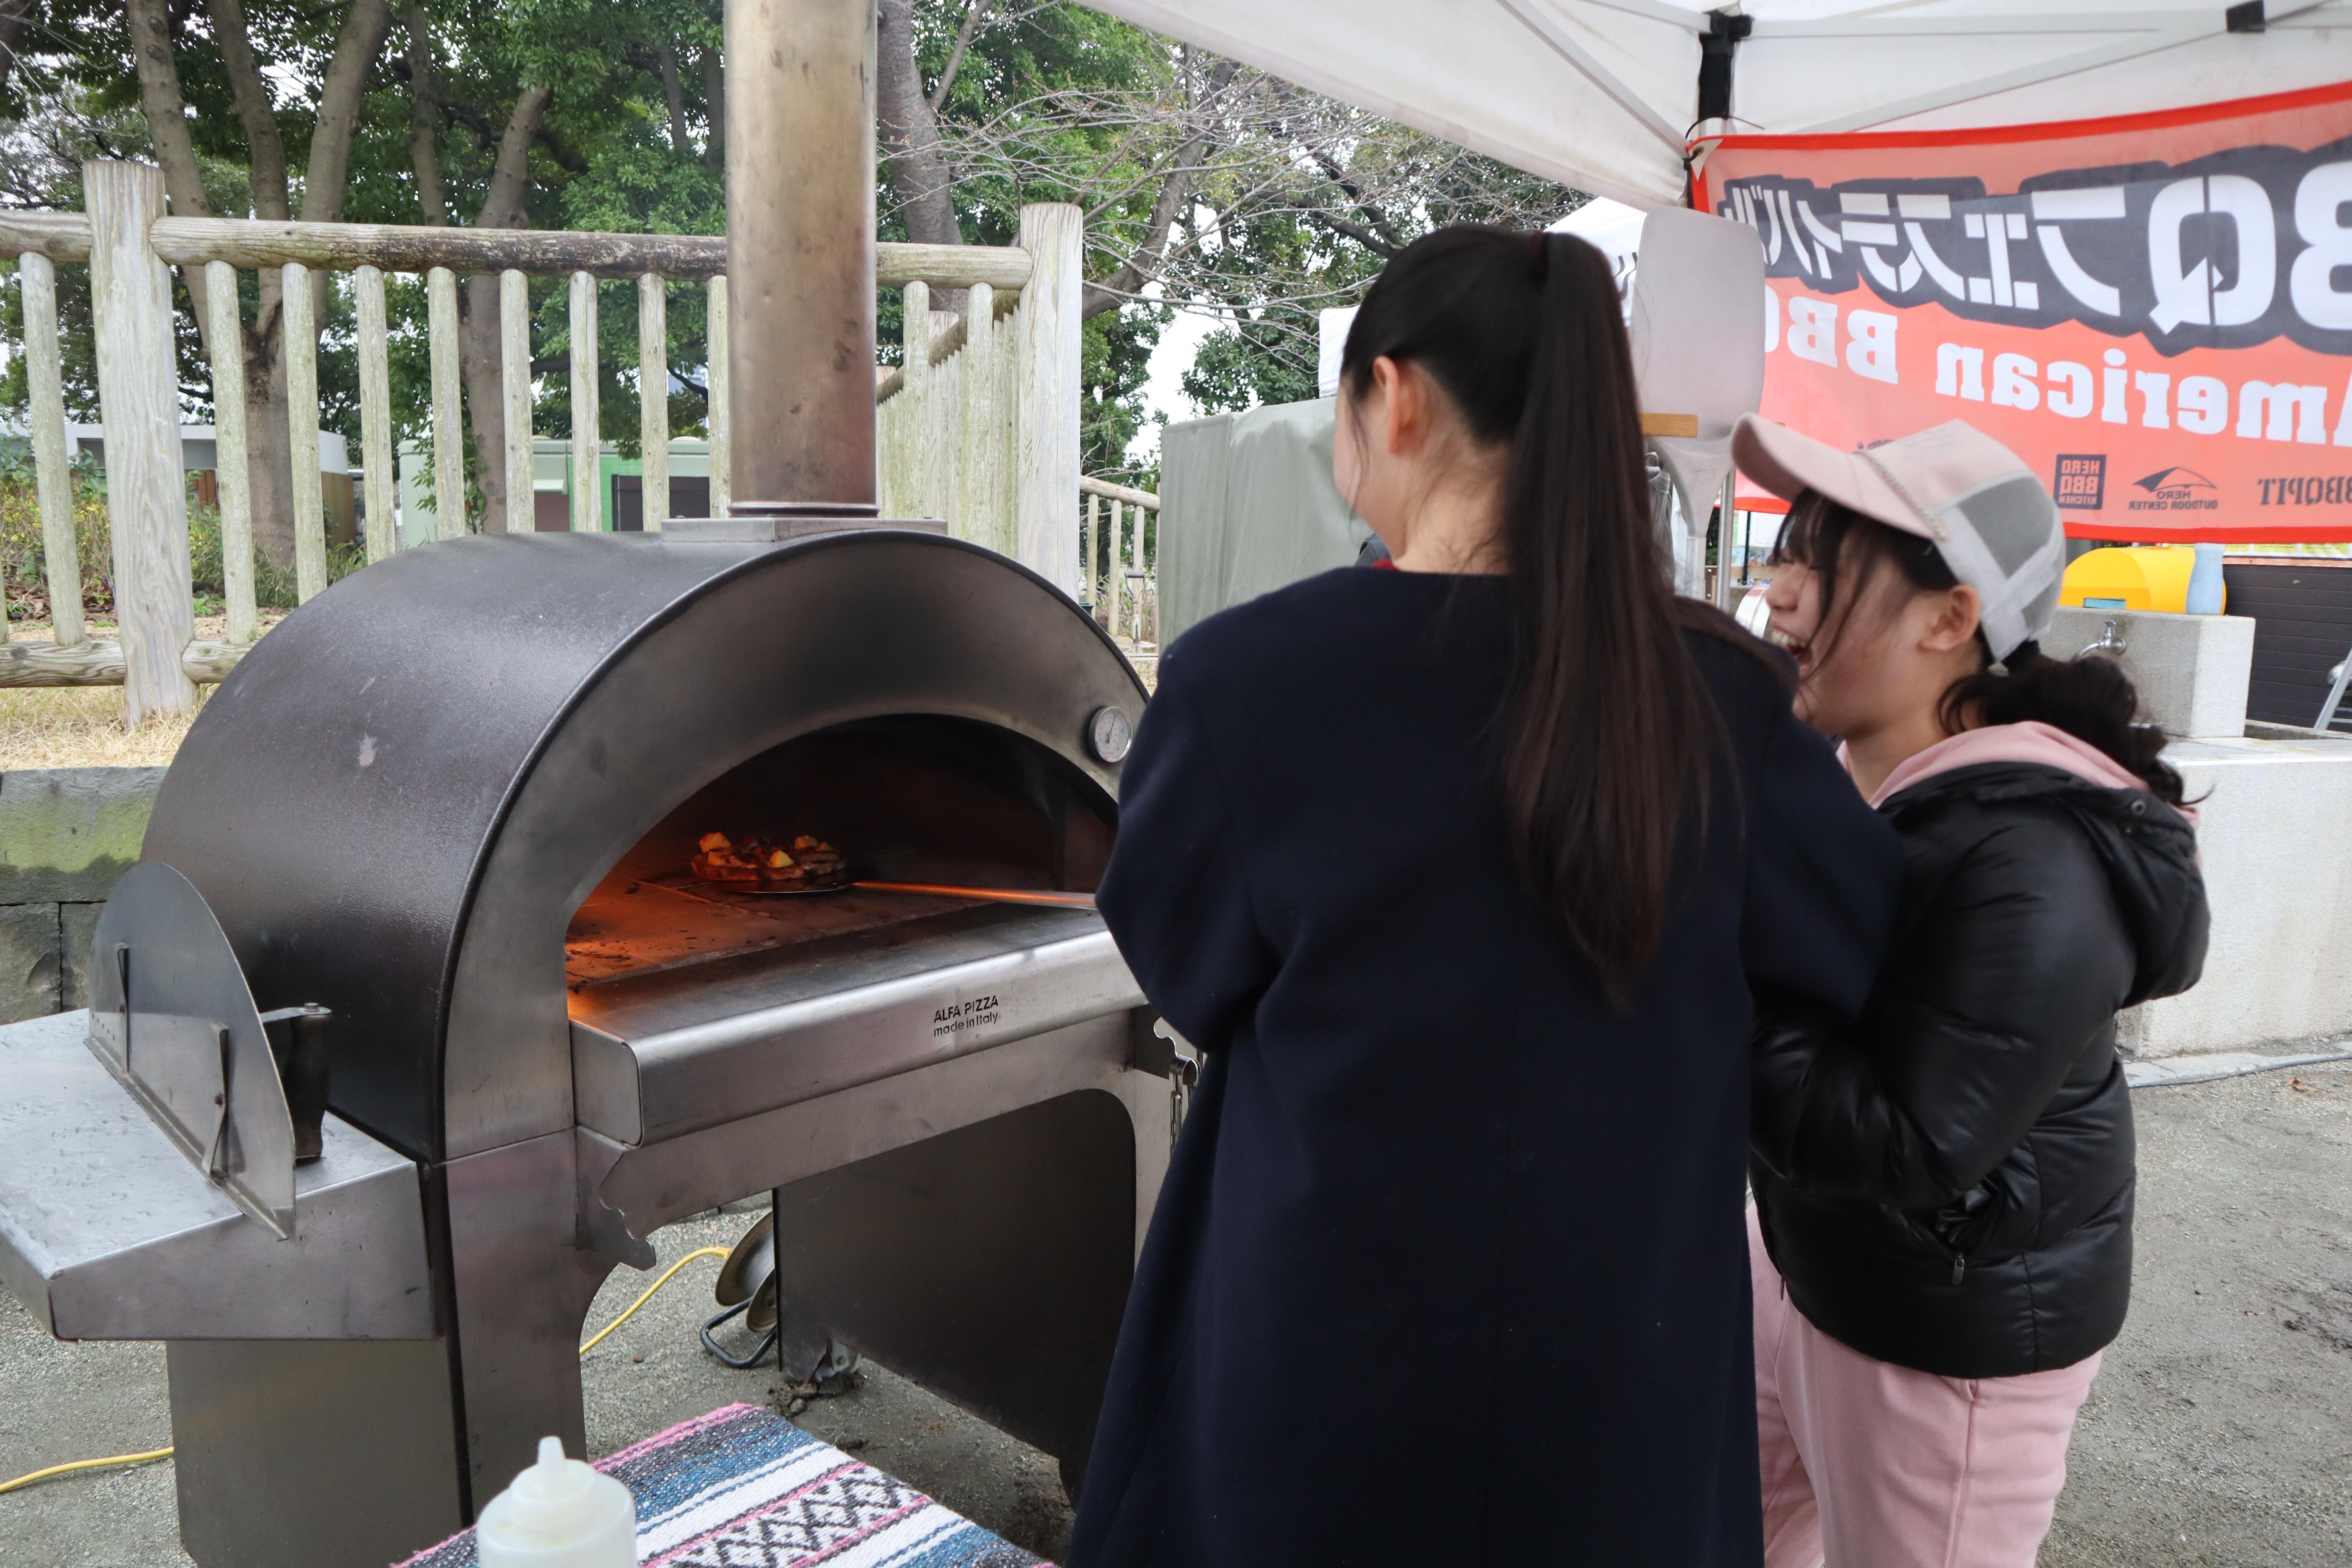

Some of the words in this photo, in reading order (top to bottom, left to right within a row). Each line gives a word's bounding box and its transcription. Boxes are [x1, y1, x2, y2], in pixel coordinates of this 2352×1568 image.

[934, 1005, 961, 1023] ALFA
[965, 995, 999, 1015] PIZZA
[934, 1020, 964, 1037] made
[967, 1018, 975, 1029] in
[976, 1011, 998, 1025] Italy
